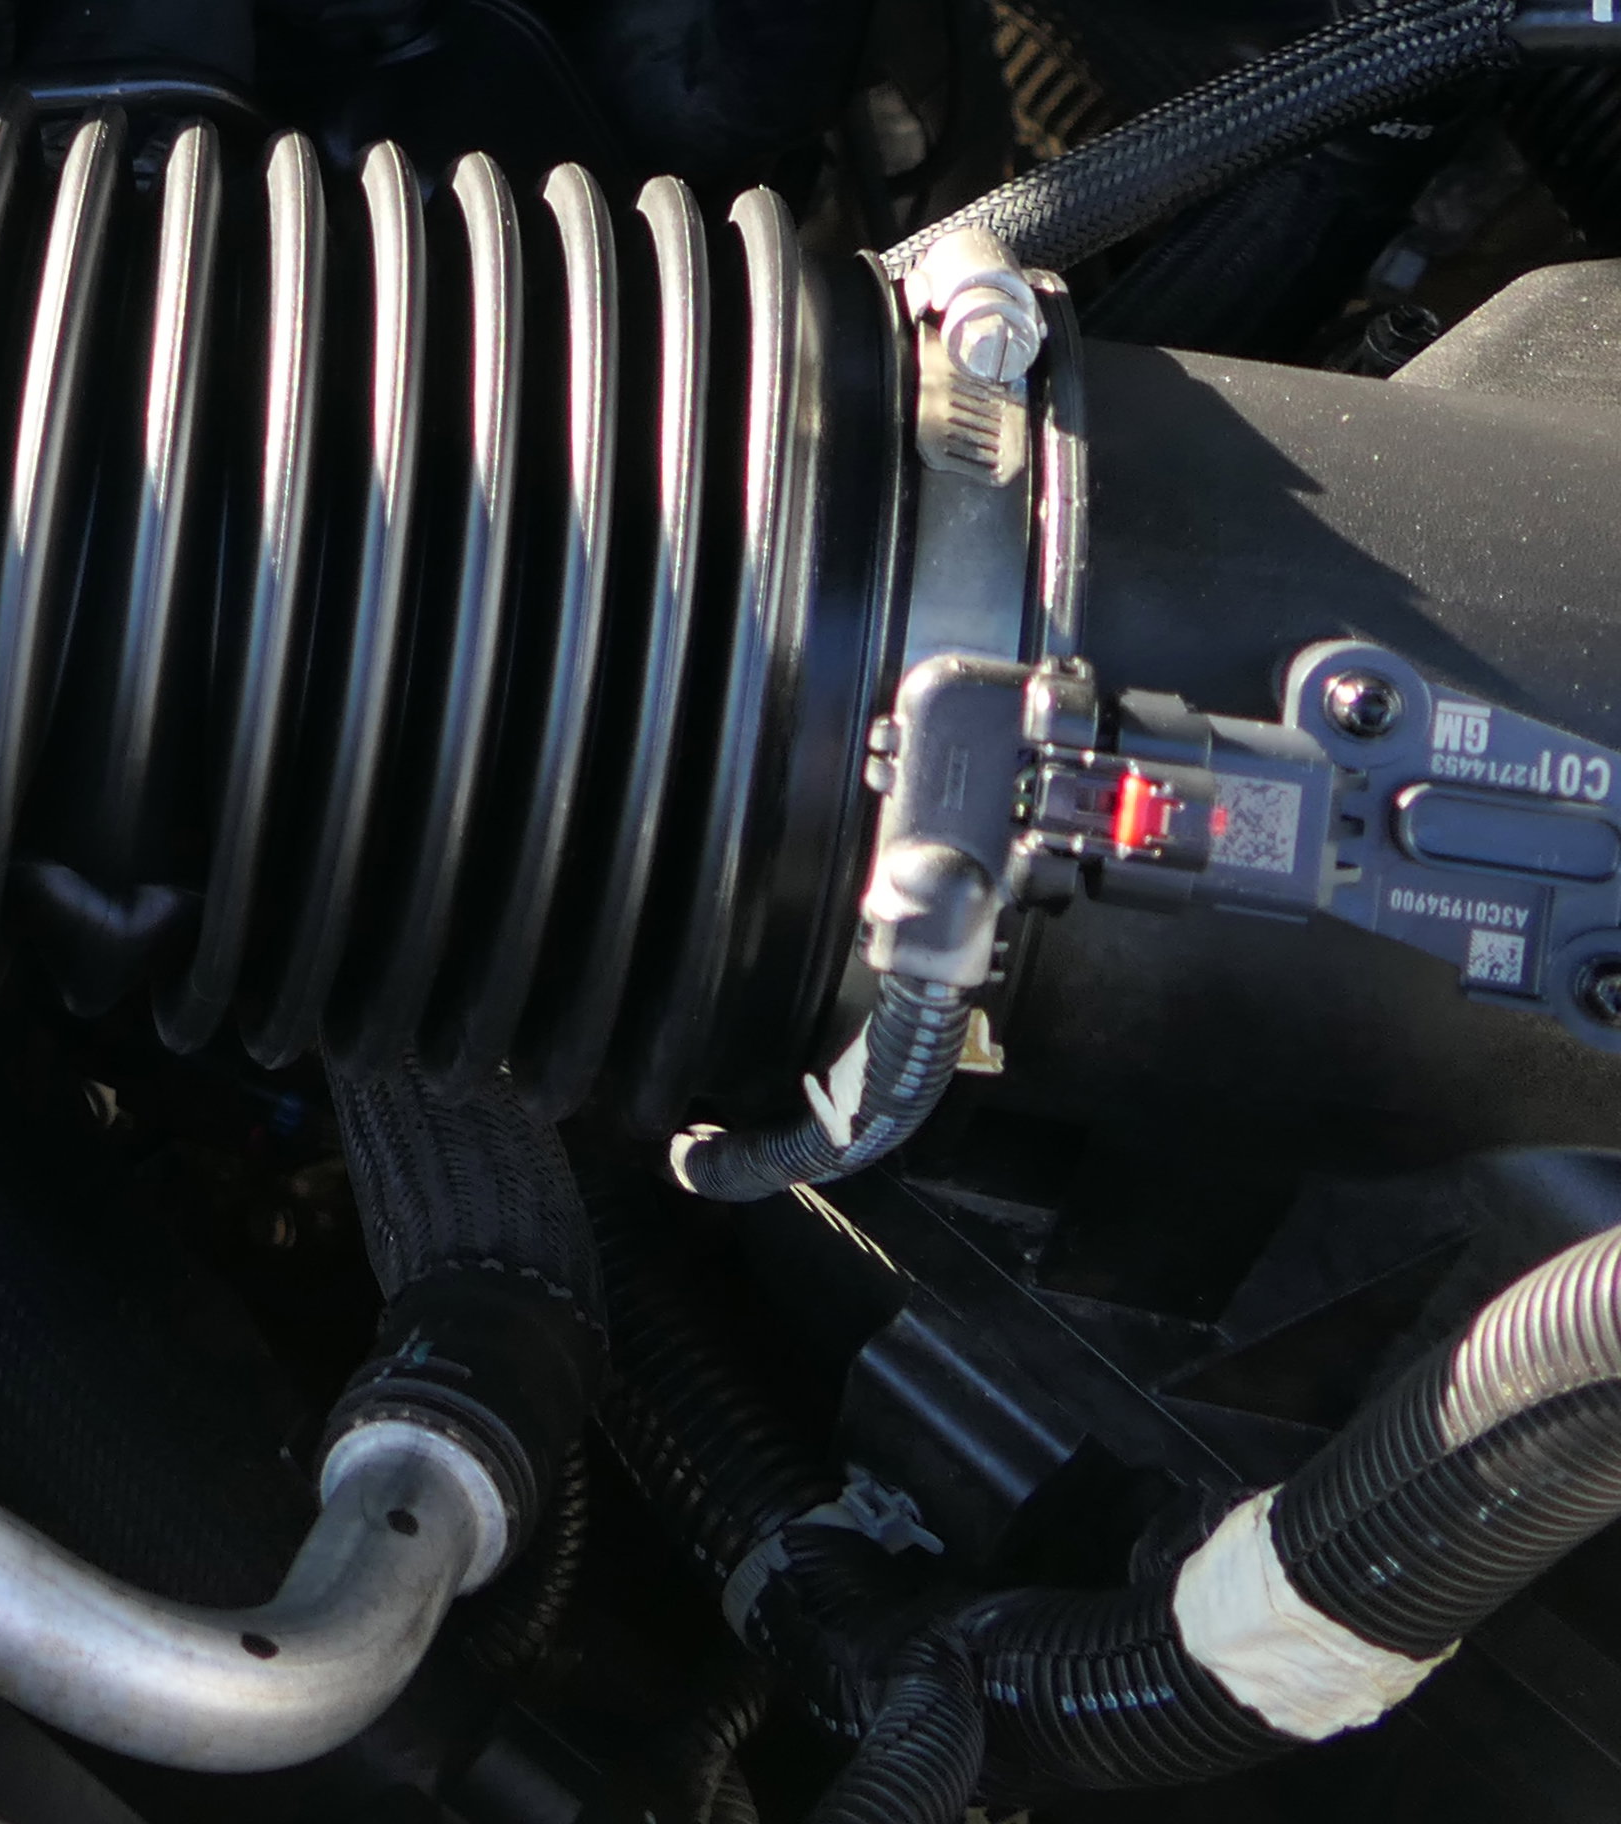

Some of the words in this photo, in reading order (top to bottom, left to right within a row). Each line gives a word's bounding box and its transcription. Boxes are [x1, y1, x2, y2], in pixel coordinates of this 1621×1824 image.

[1432, 710, 1490, 755] GM
[1430, 752, 1539, 790] 12714453
[1538, 749, 1612, 800] C01
[1390, 887, 1530, 929] A3C01954900
